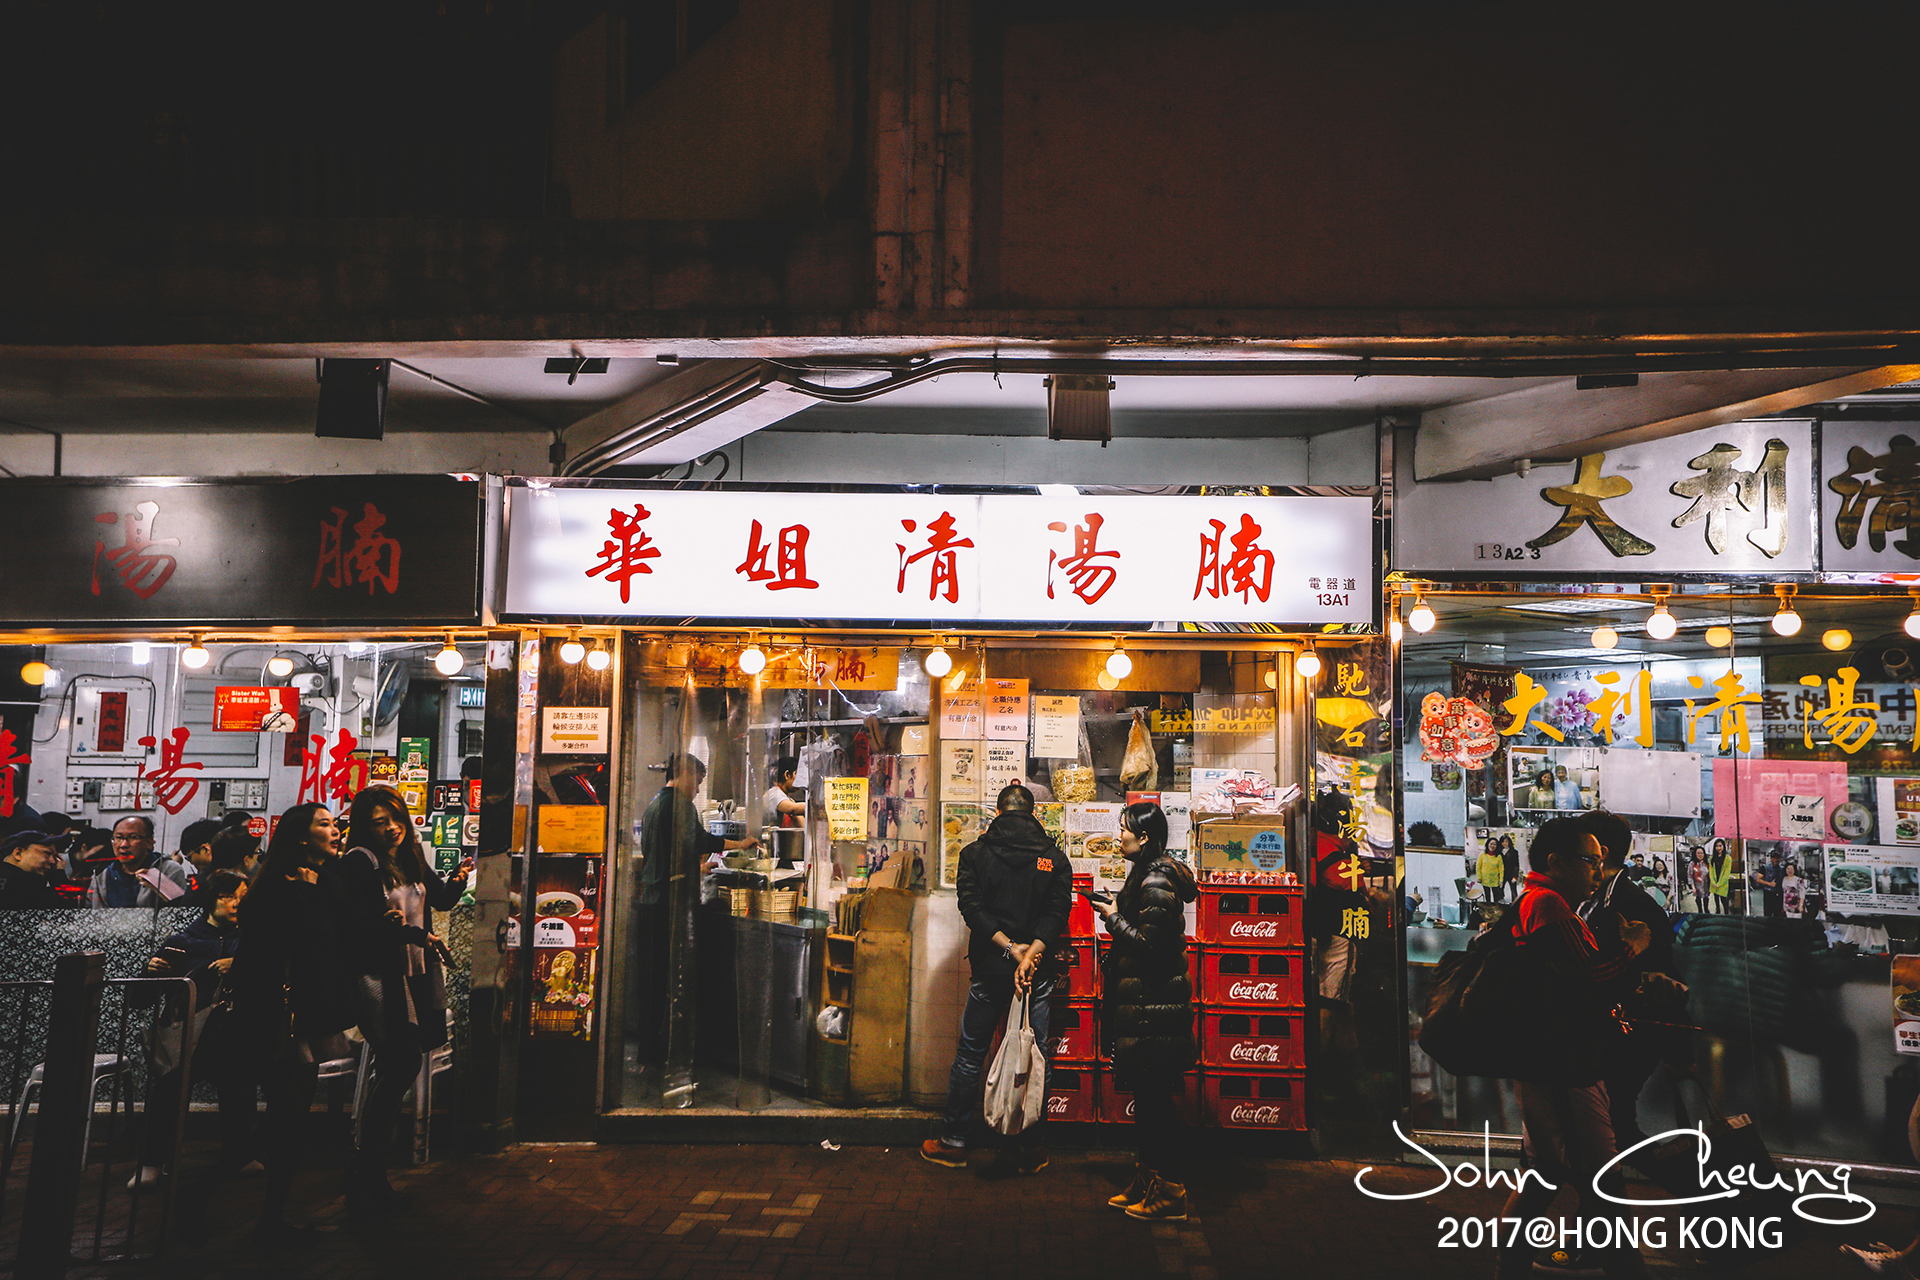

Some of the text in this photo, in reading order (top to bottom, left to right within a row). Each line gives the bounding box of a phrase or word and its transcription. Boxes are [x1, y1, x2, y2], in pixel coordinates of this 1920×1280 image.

[585, 503, 1276, 606] 華姐清湯腩
[1308, 577, 1356, 591] 電器道
[1316, 594, 1350, 607] 13A1
[461, 687, 485, 706] EXIT
[1500, 666, 1920, 754] 大利清湯
[1204, 842, 1241, 851] Bonaqua
[1230, 921, 1278, 937] Coca-Cola
[1229, 982, 1278, 1000] Coca-Cola
[1230, 1043, 1279, 1062] Coca-Cola
[1231, 1105, 1280, 1123] Coca-Cola
